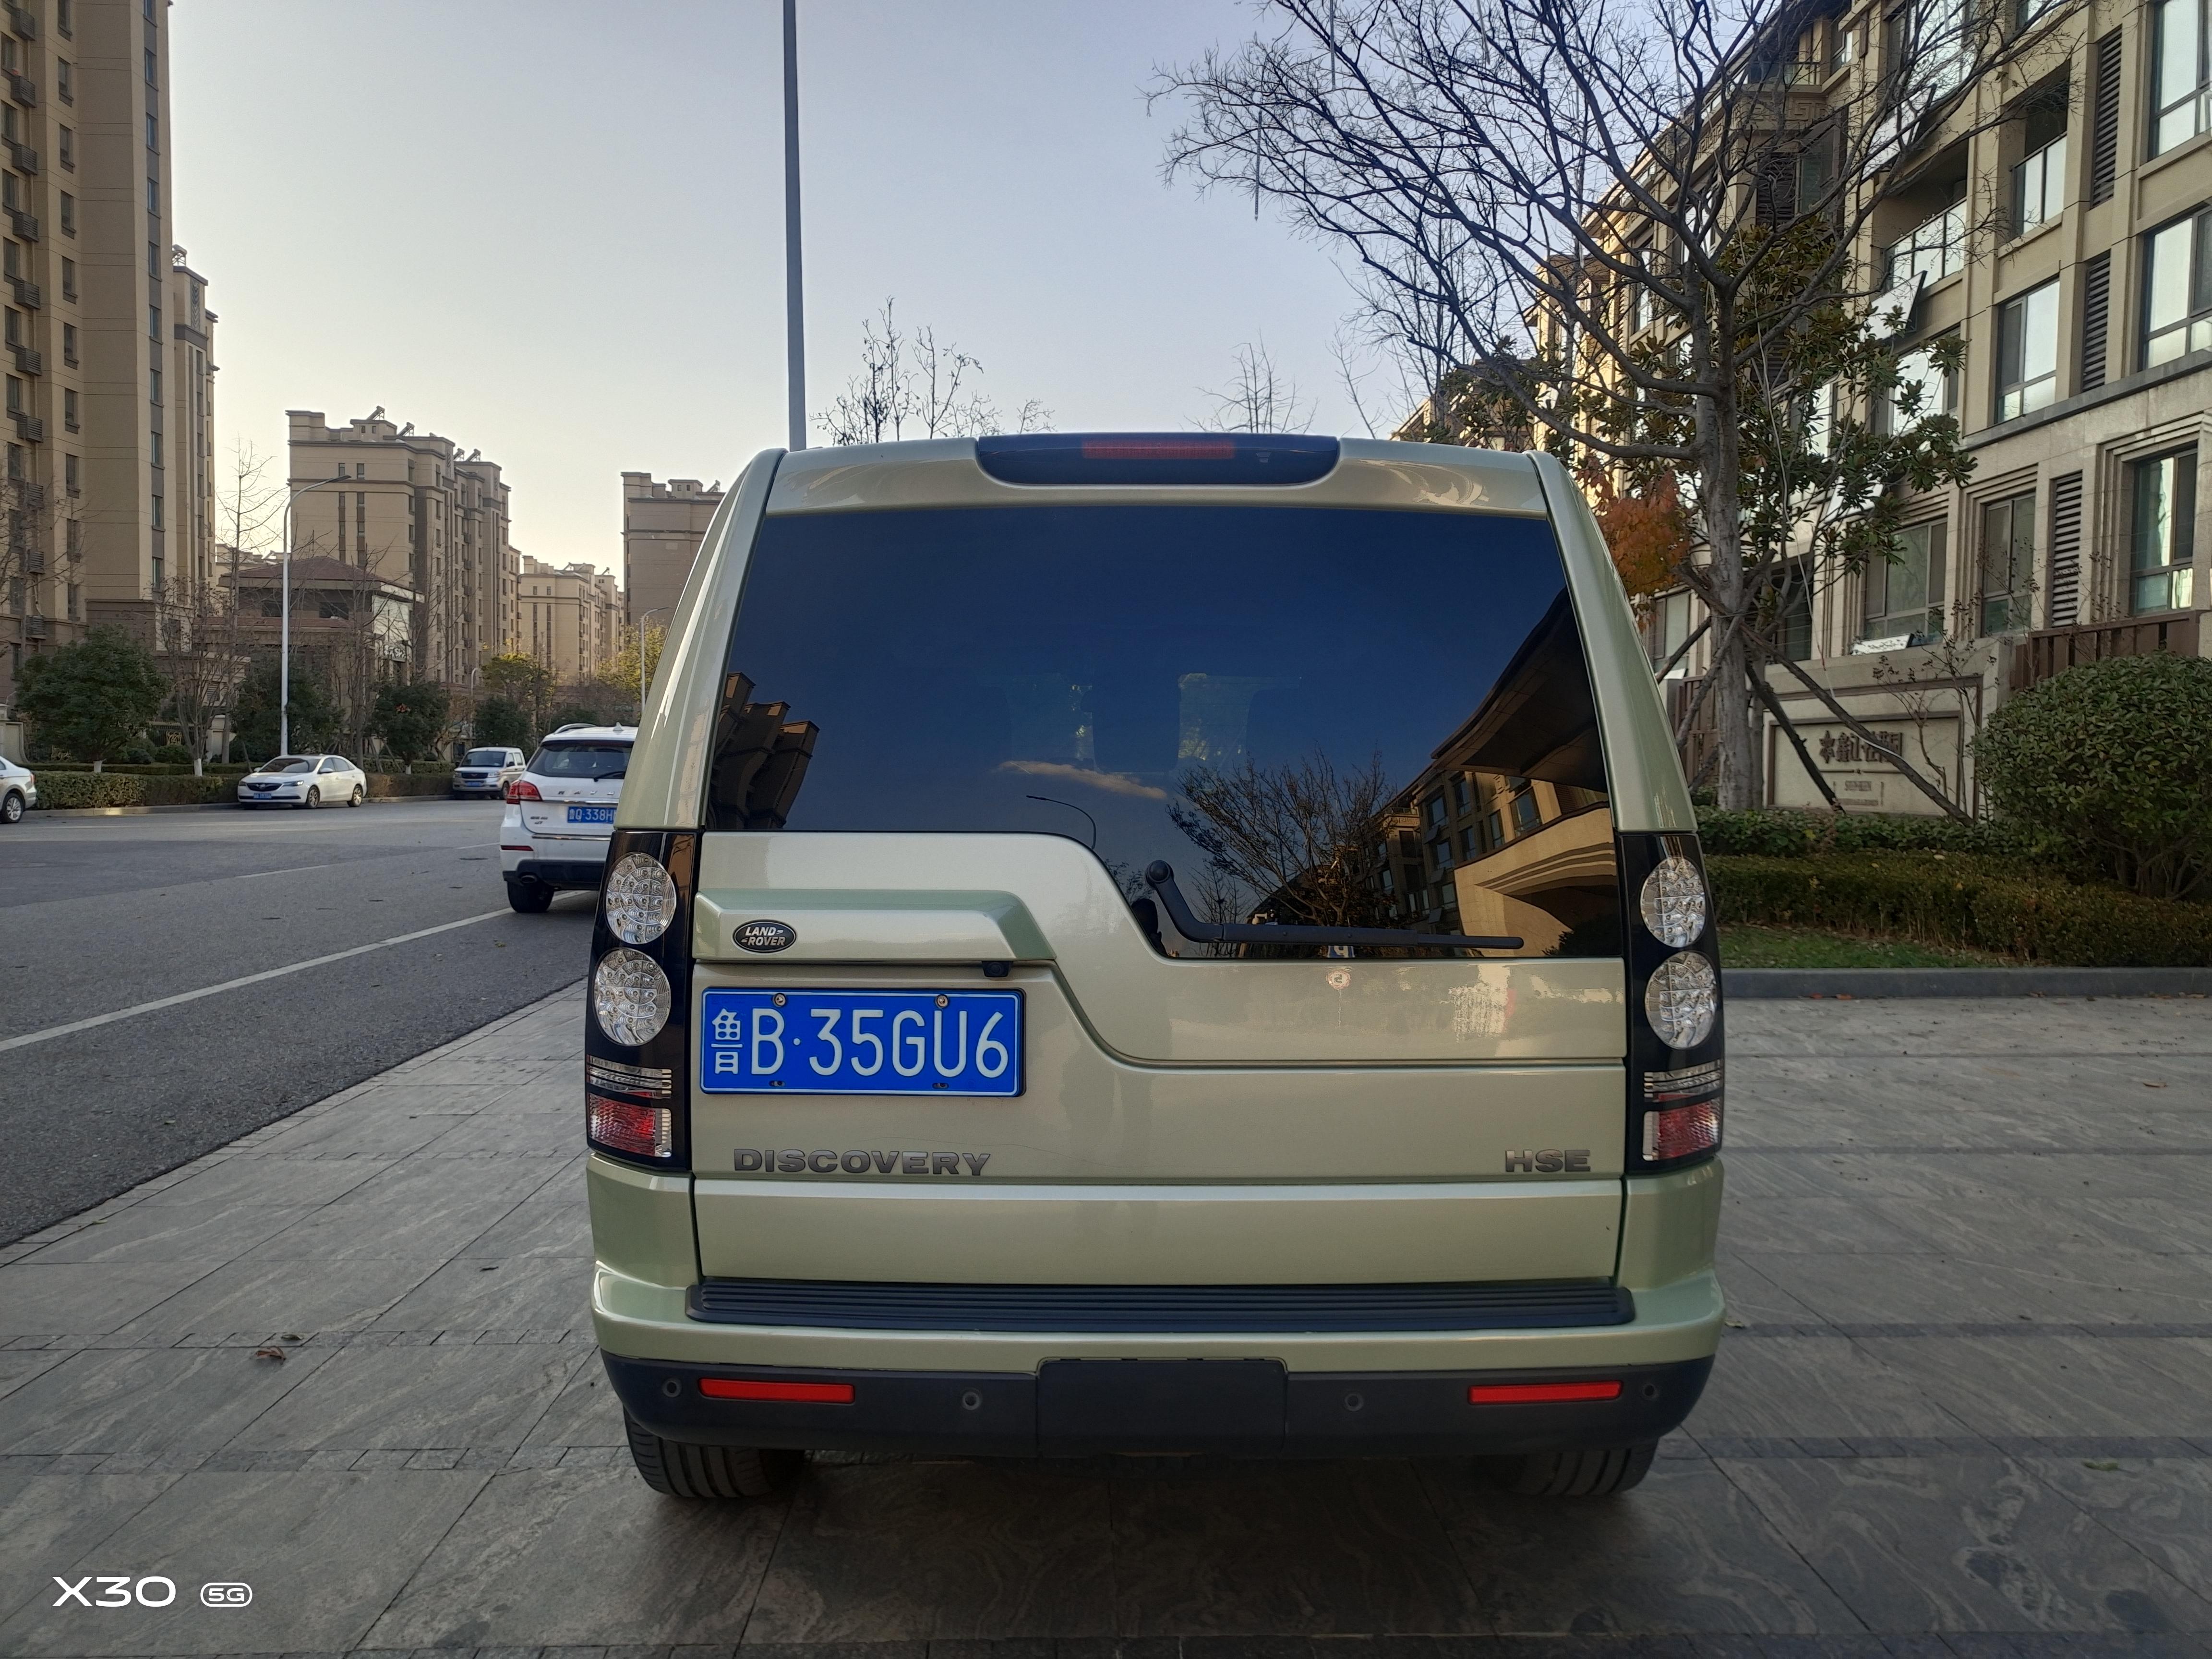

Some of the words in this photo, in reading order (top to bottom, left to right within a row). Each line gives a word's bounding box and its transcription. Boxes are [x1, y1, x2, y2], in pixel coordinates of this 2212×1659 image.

[745, 926, 777, 936] LAND
[747, 937, 786, 946] ROVER
[733, 1148, 991, 1176] DISCOVERY
[1505, 1149, 1591, 1172] HSE
